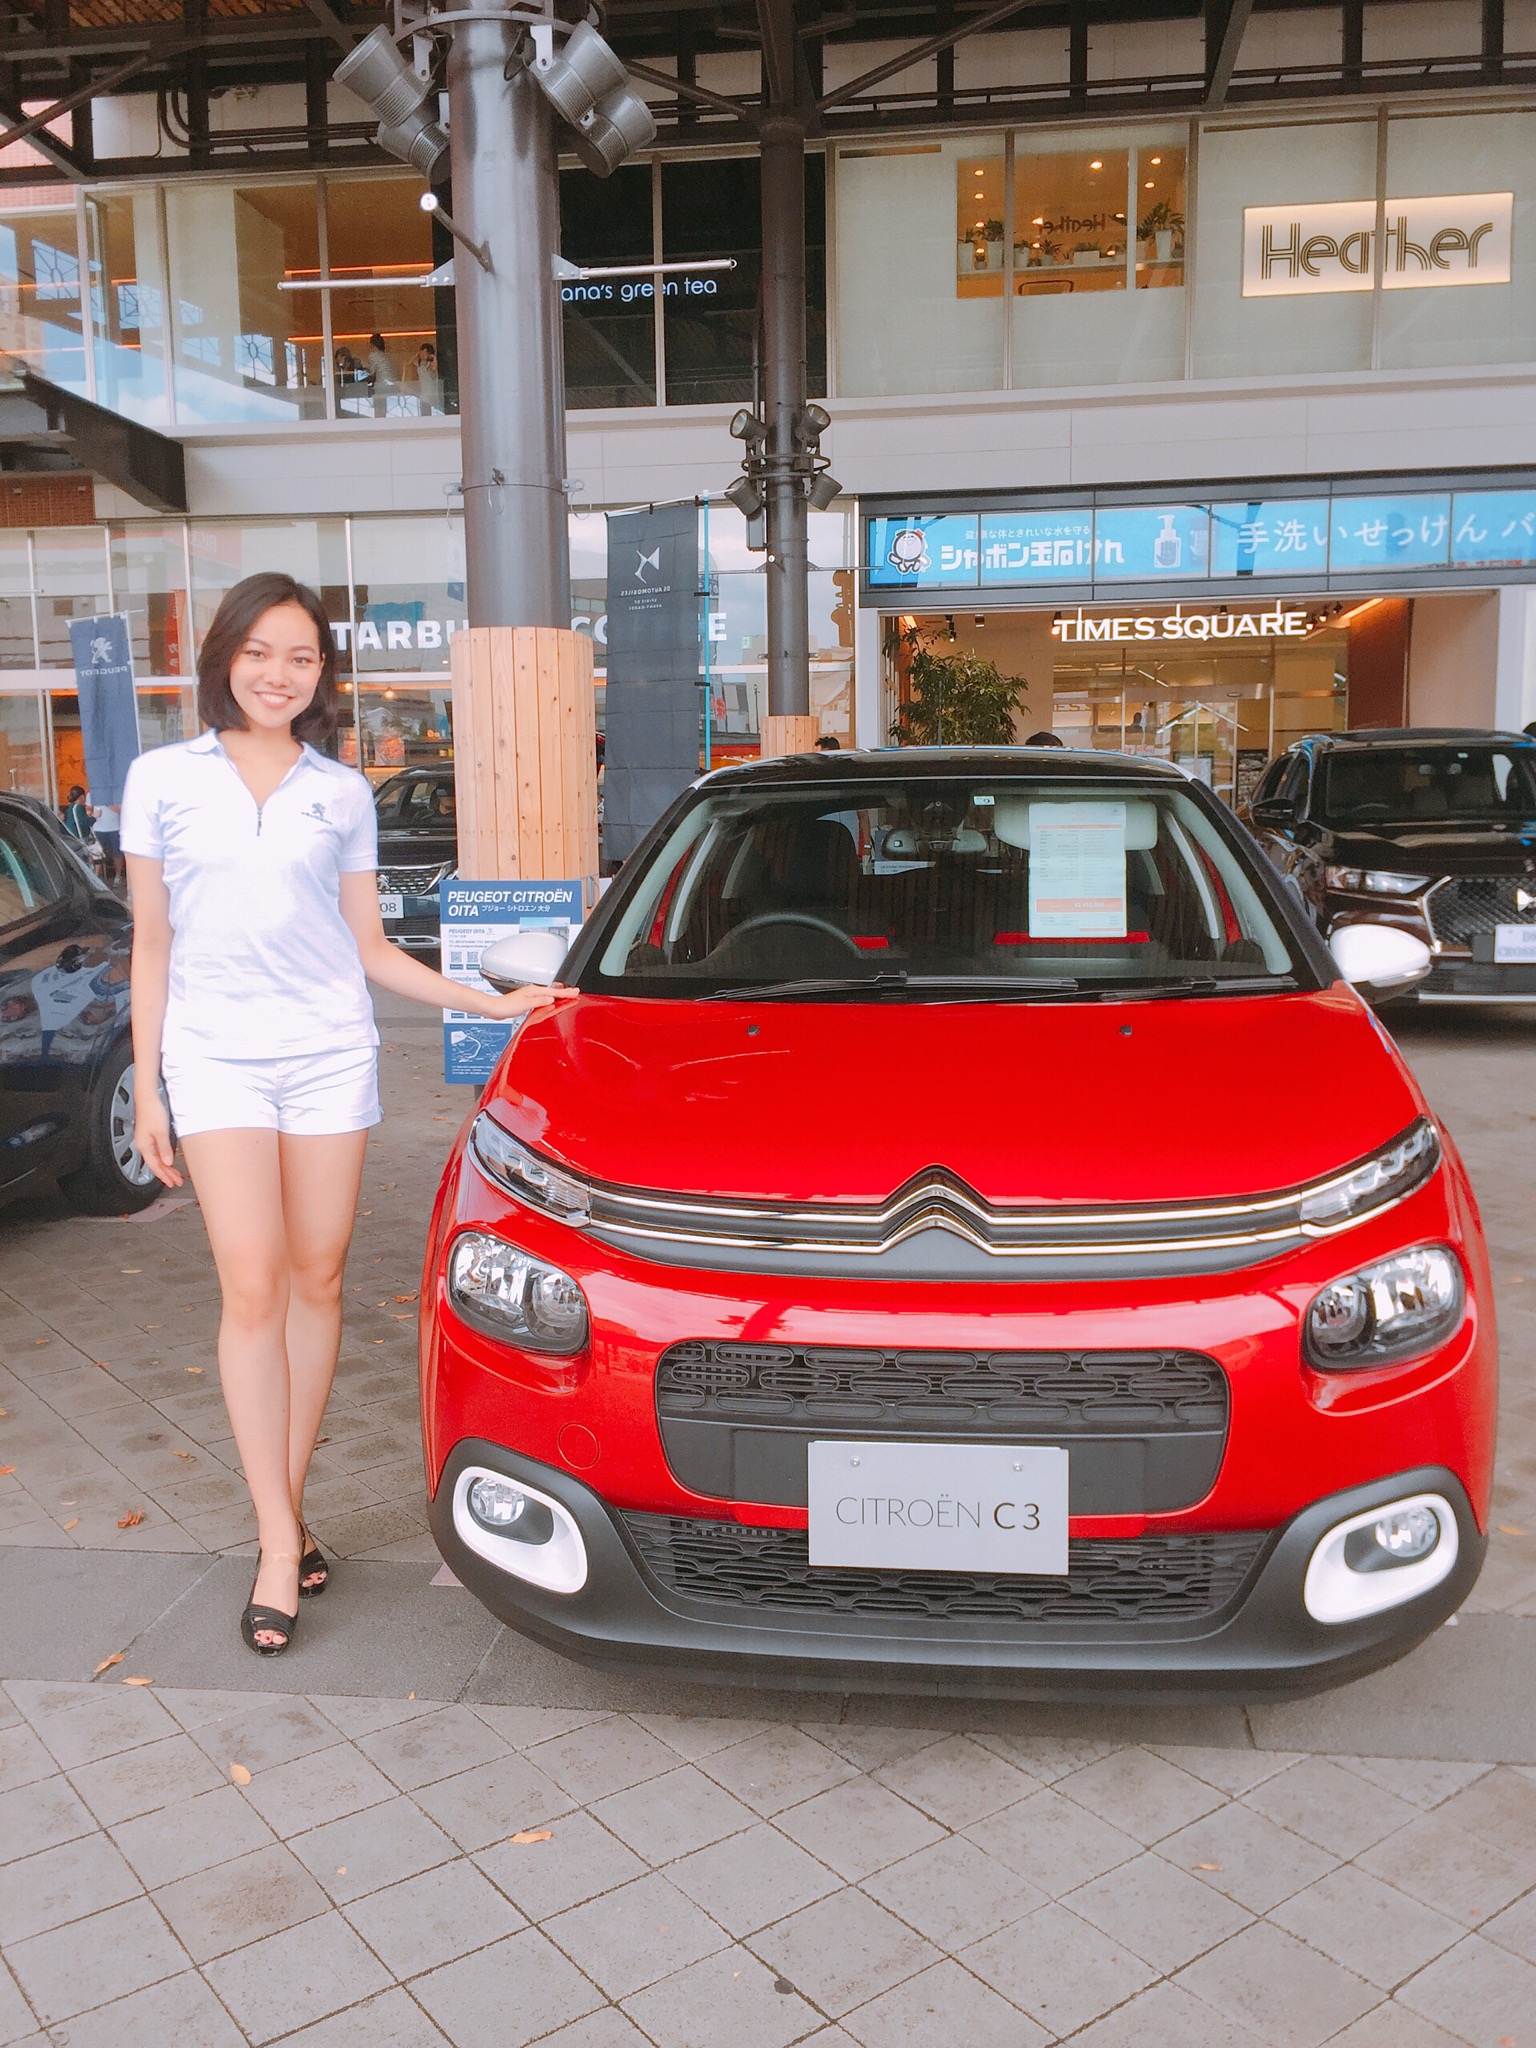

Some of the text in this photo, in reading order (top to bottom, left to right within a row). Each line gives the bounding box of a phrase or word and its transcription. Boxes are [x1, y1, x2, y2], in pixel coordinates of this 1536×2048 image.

[561, 284, 613, 302] ana's
[683, 276, 718, 295] tea
[1237, 513, 1488, 555] 手洗いせっけん
[941, 538, 1125, 571] シャボン玉石けん
[1053, 611, 1308, 642] TIMES SQUARE
[447, 888, 573, 903] PEUGEOT CITROËN
[448, 904, 479, 917] OITA
[537, 904, 551, 912] 大分
[836, 1493, 1041, 1531] CITROËN C3
